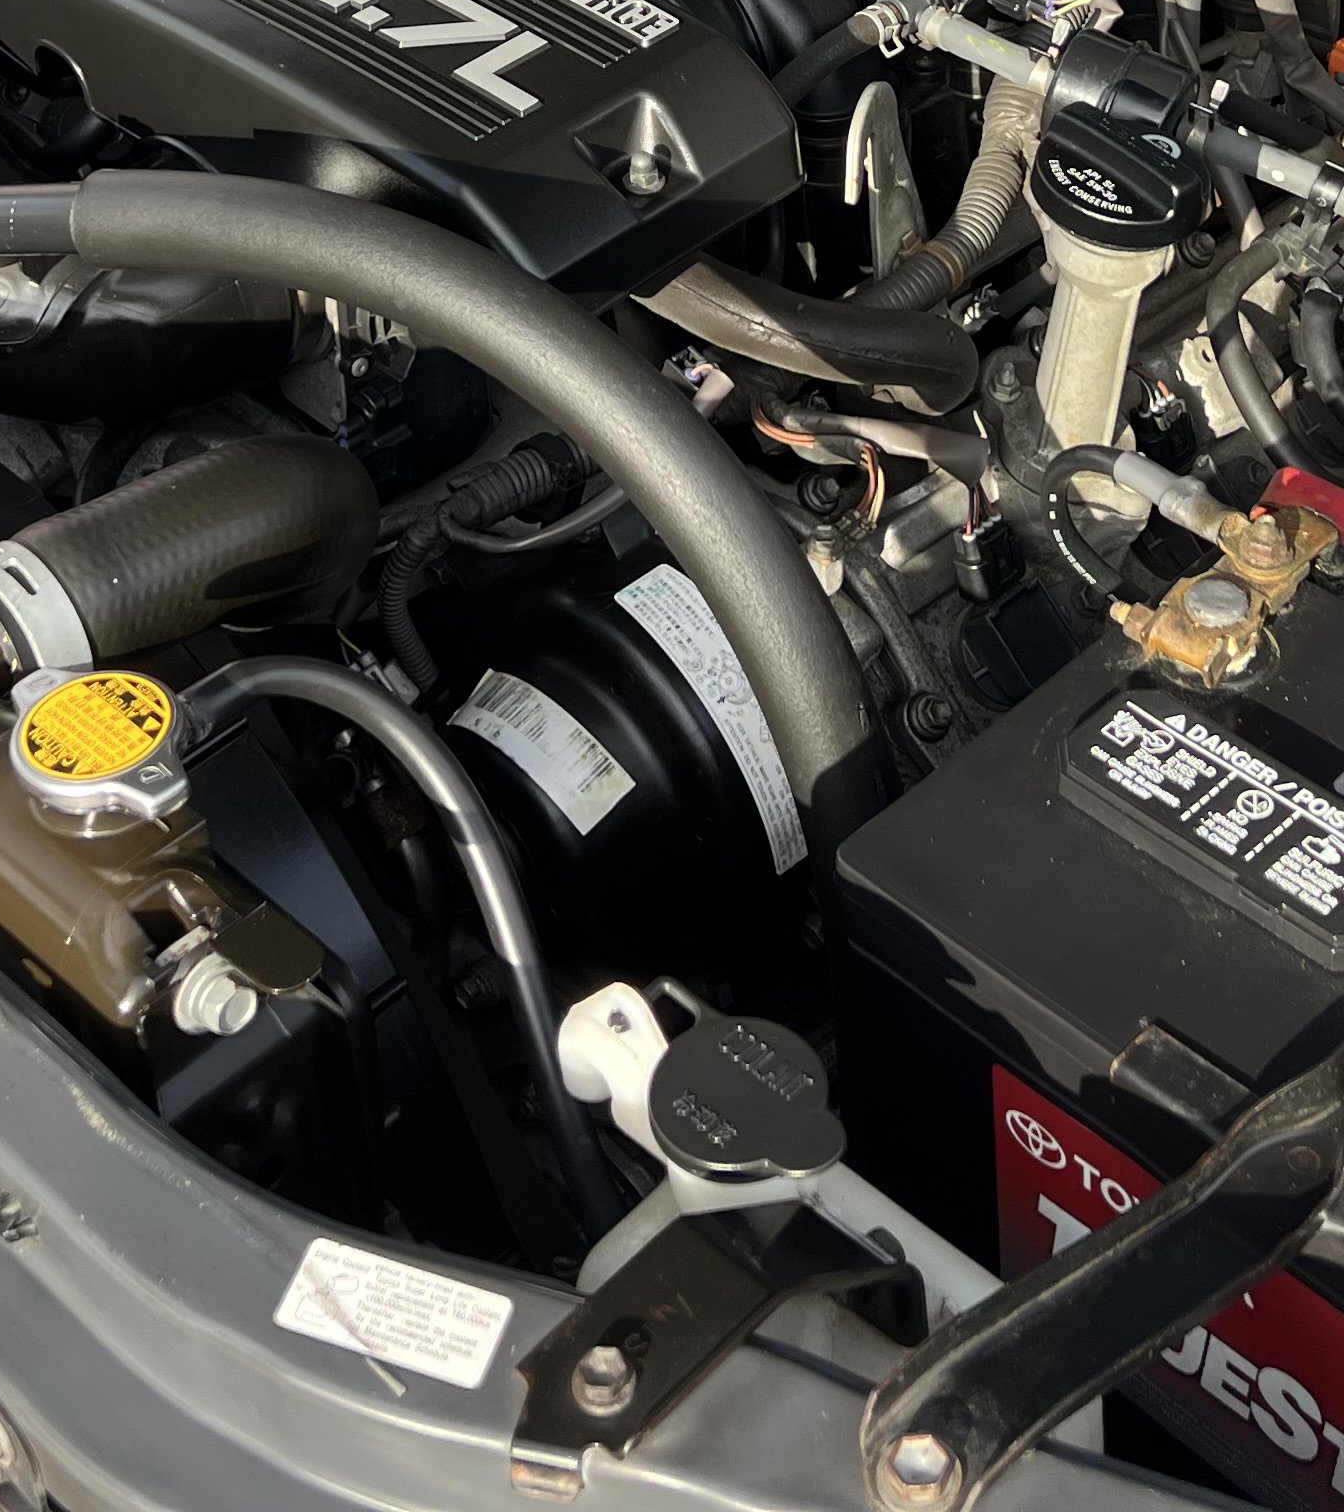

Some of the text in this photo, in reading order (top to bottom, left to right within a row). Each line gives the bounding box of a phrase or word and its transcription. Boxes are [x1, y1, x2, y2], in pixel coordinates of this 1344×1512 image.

[1048, 159, 1133, 215] ENERGY CONSERVING
[1067, 167, 1088, 183] SAE
[28, 727, 78, 768] CAUTION
[1175, 748, 1217, 778] SHIELD
[1186, 723, 1279, 786] DANGER
[1273, 782, 1299, 792] /
[1125, 755, 1165, 785] GASES
[1134, 747, 1197, 791] EXPLOSIVE
[1166, 756, 1198, 780] EYES
[1227, 808, 1249, 825] NO
[718, 1024, 814, 1101] COOLANT
